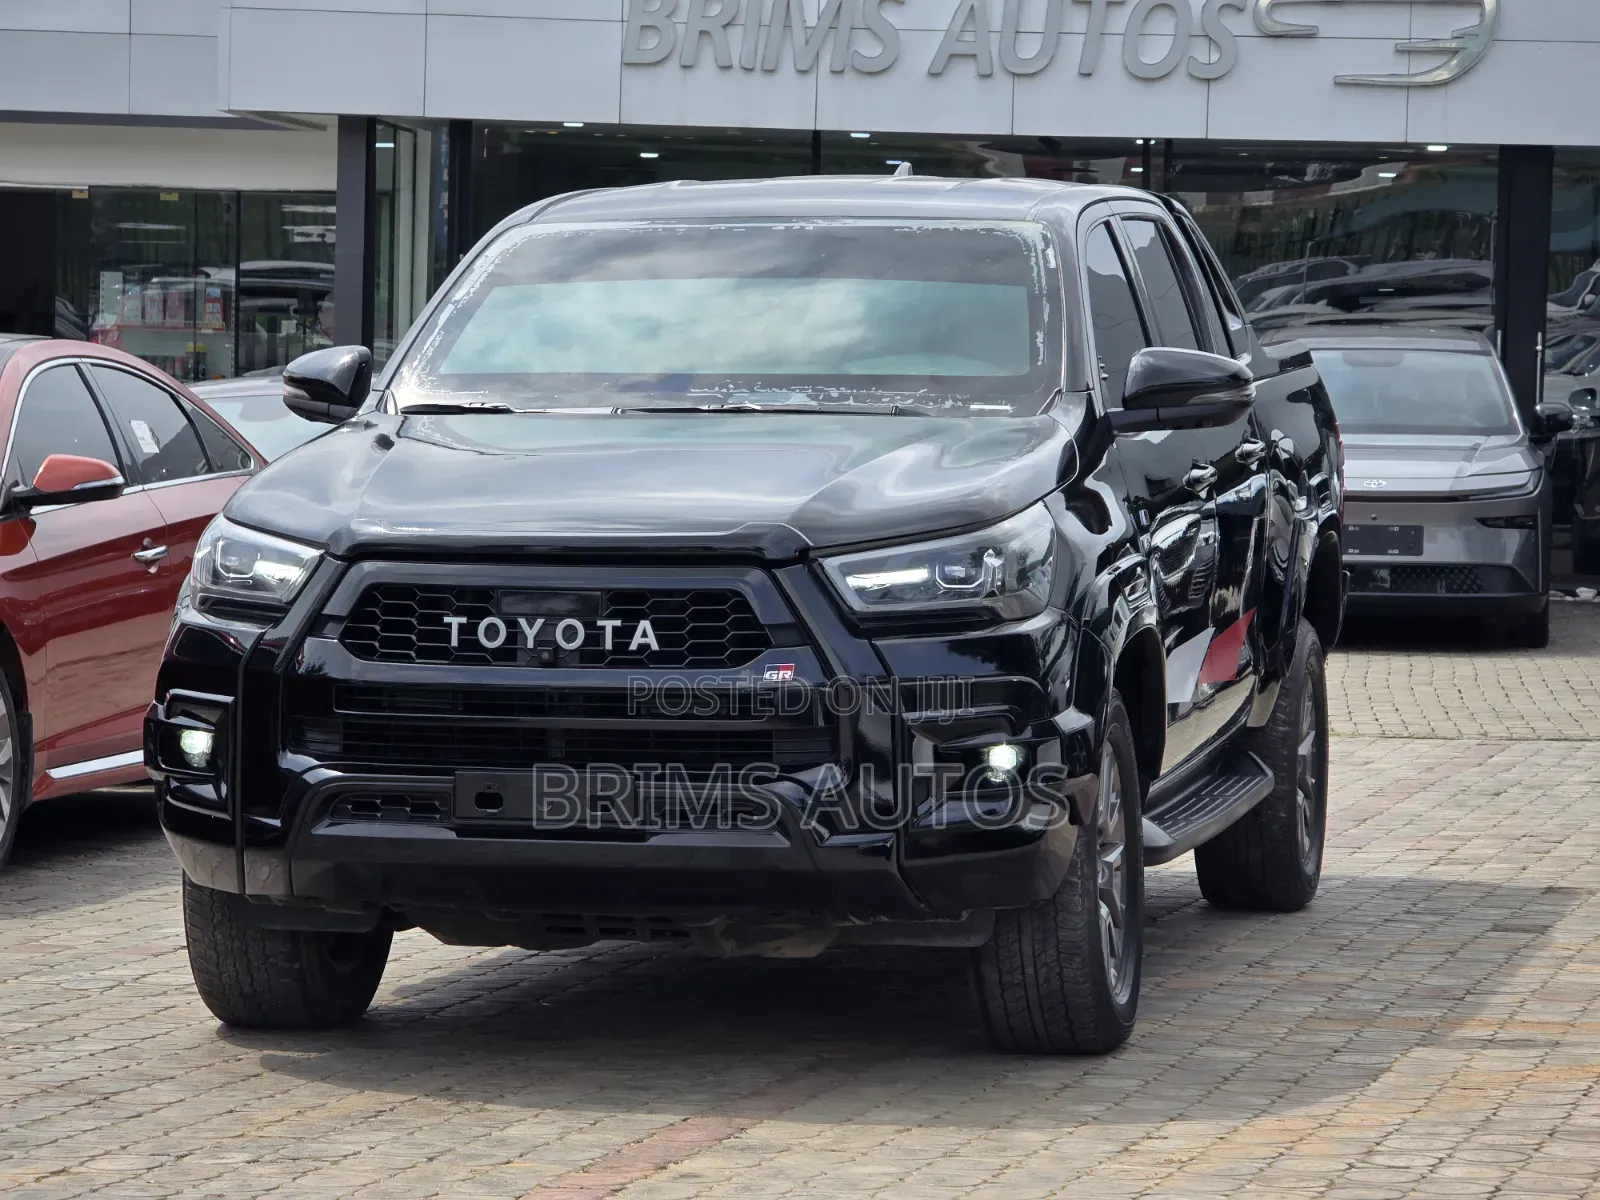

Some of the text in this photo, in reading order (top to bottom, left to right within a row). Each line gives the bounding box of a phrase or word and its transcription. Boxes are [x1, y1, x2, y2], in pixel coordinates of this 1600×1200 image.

[622, 0, 1246, 80] BRIMS AUTOS
[443, 616, 660, 651] TOYOTA
[764, 668, 793, 681] GR
